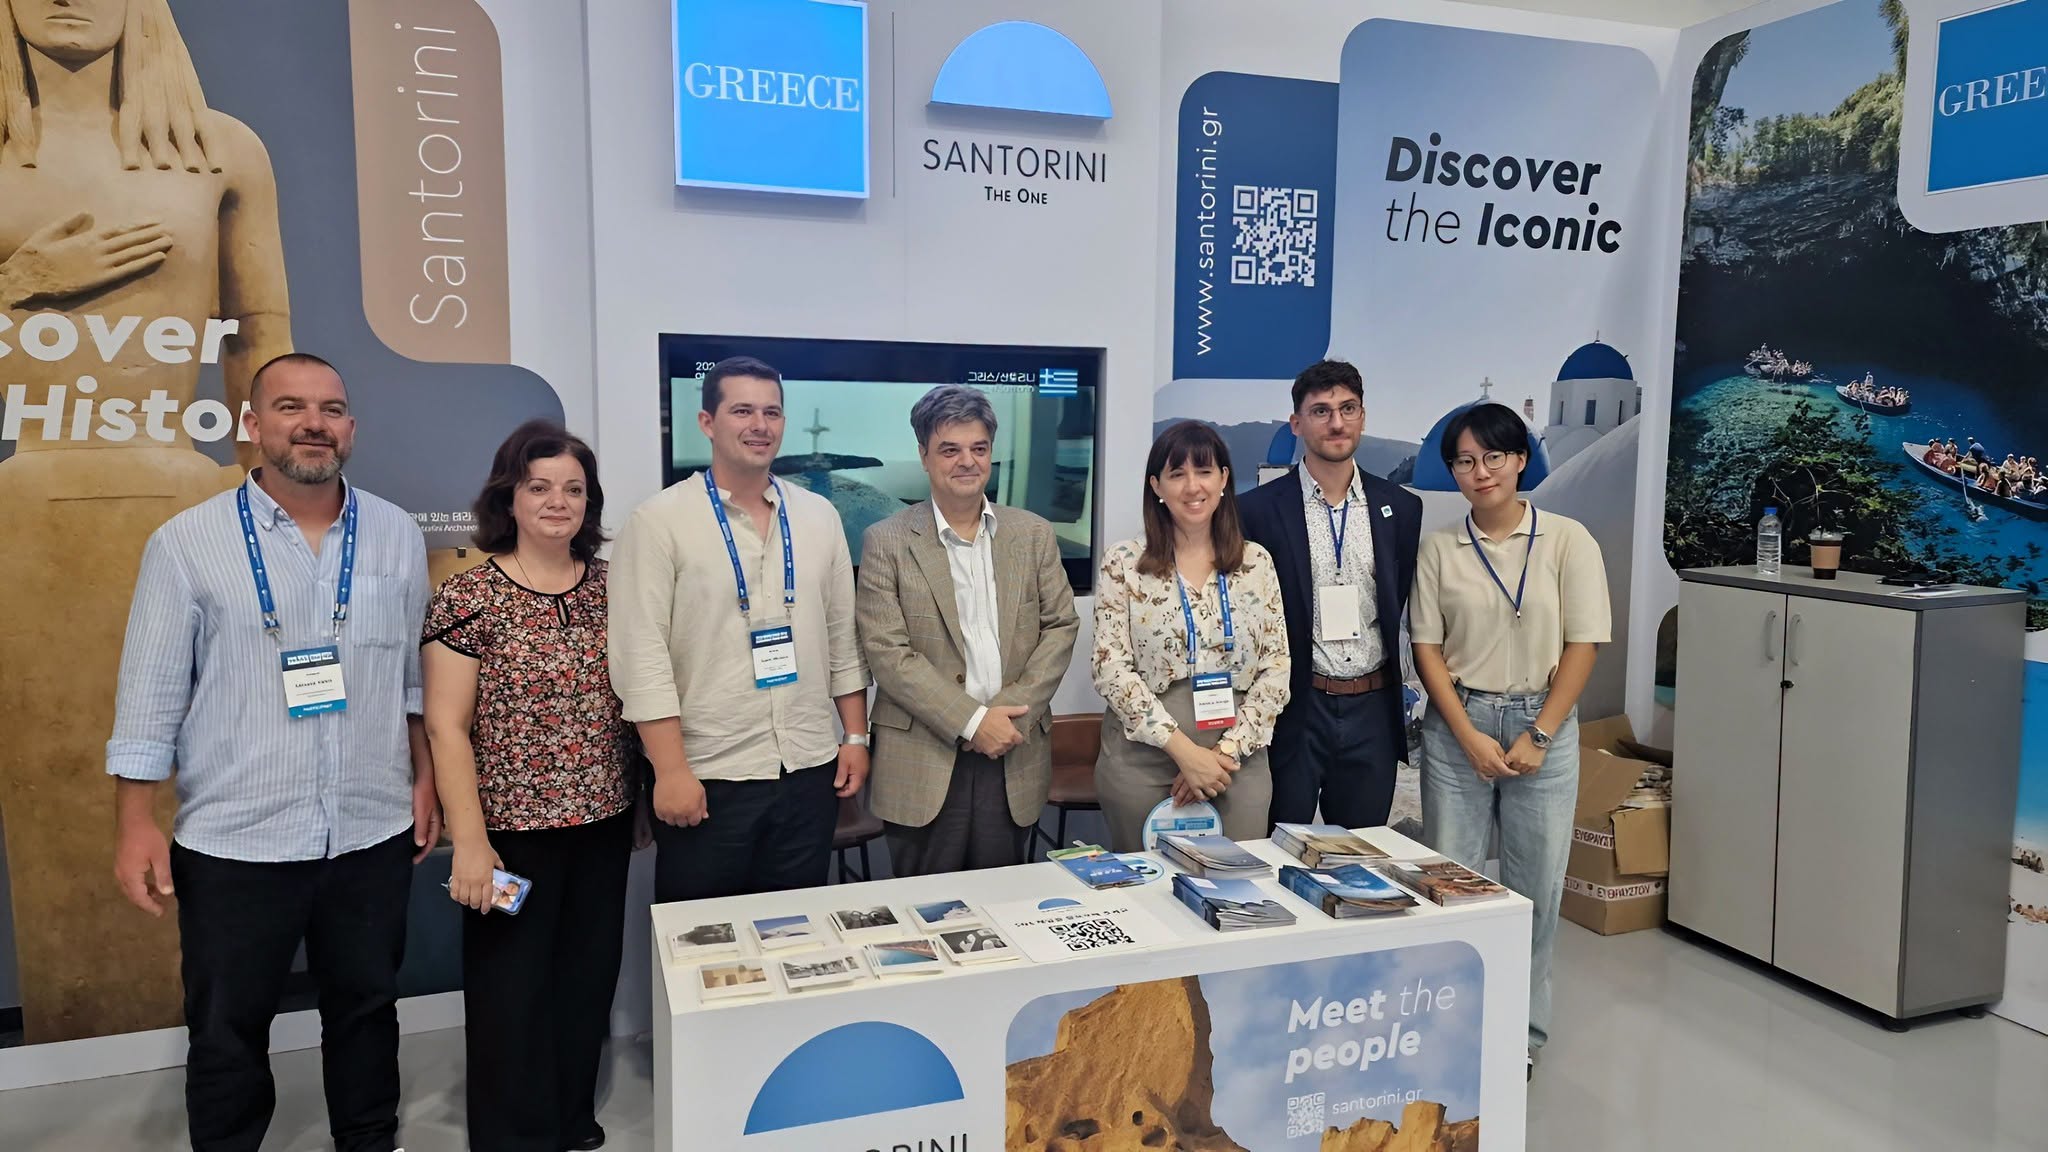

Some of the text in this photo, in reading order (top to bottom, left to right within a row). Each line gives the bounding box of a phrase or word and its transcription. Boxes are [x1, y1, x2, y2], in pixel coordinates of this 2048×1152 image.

[684, 62, 860, 113] GREECE
[1938, 66, 2047, 117] GREE
[394, 22, 468, 329] Santorini
[922, 138, 1107, 183] SANTORINI
[1384, 132, 1602, 196] Discover
[1196, 106, 1222, 355] www.santorini.gr
[1385, 192, 1622, 253] the Iconic
[0, 312, 239, 364] over
[452, 511, 474, 522] 테라
[1287, 978, 1457, 1033] Meet the
[1284, 1021, 1422, 1083] people
[1333, 1087, 1423, 1115] santorini.gr
